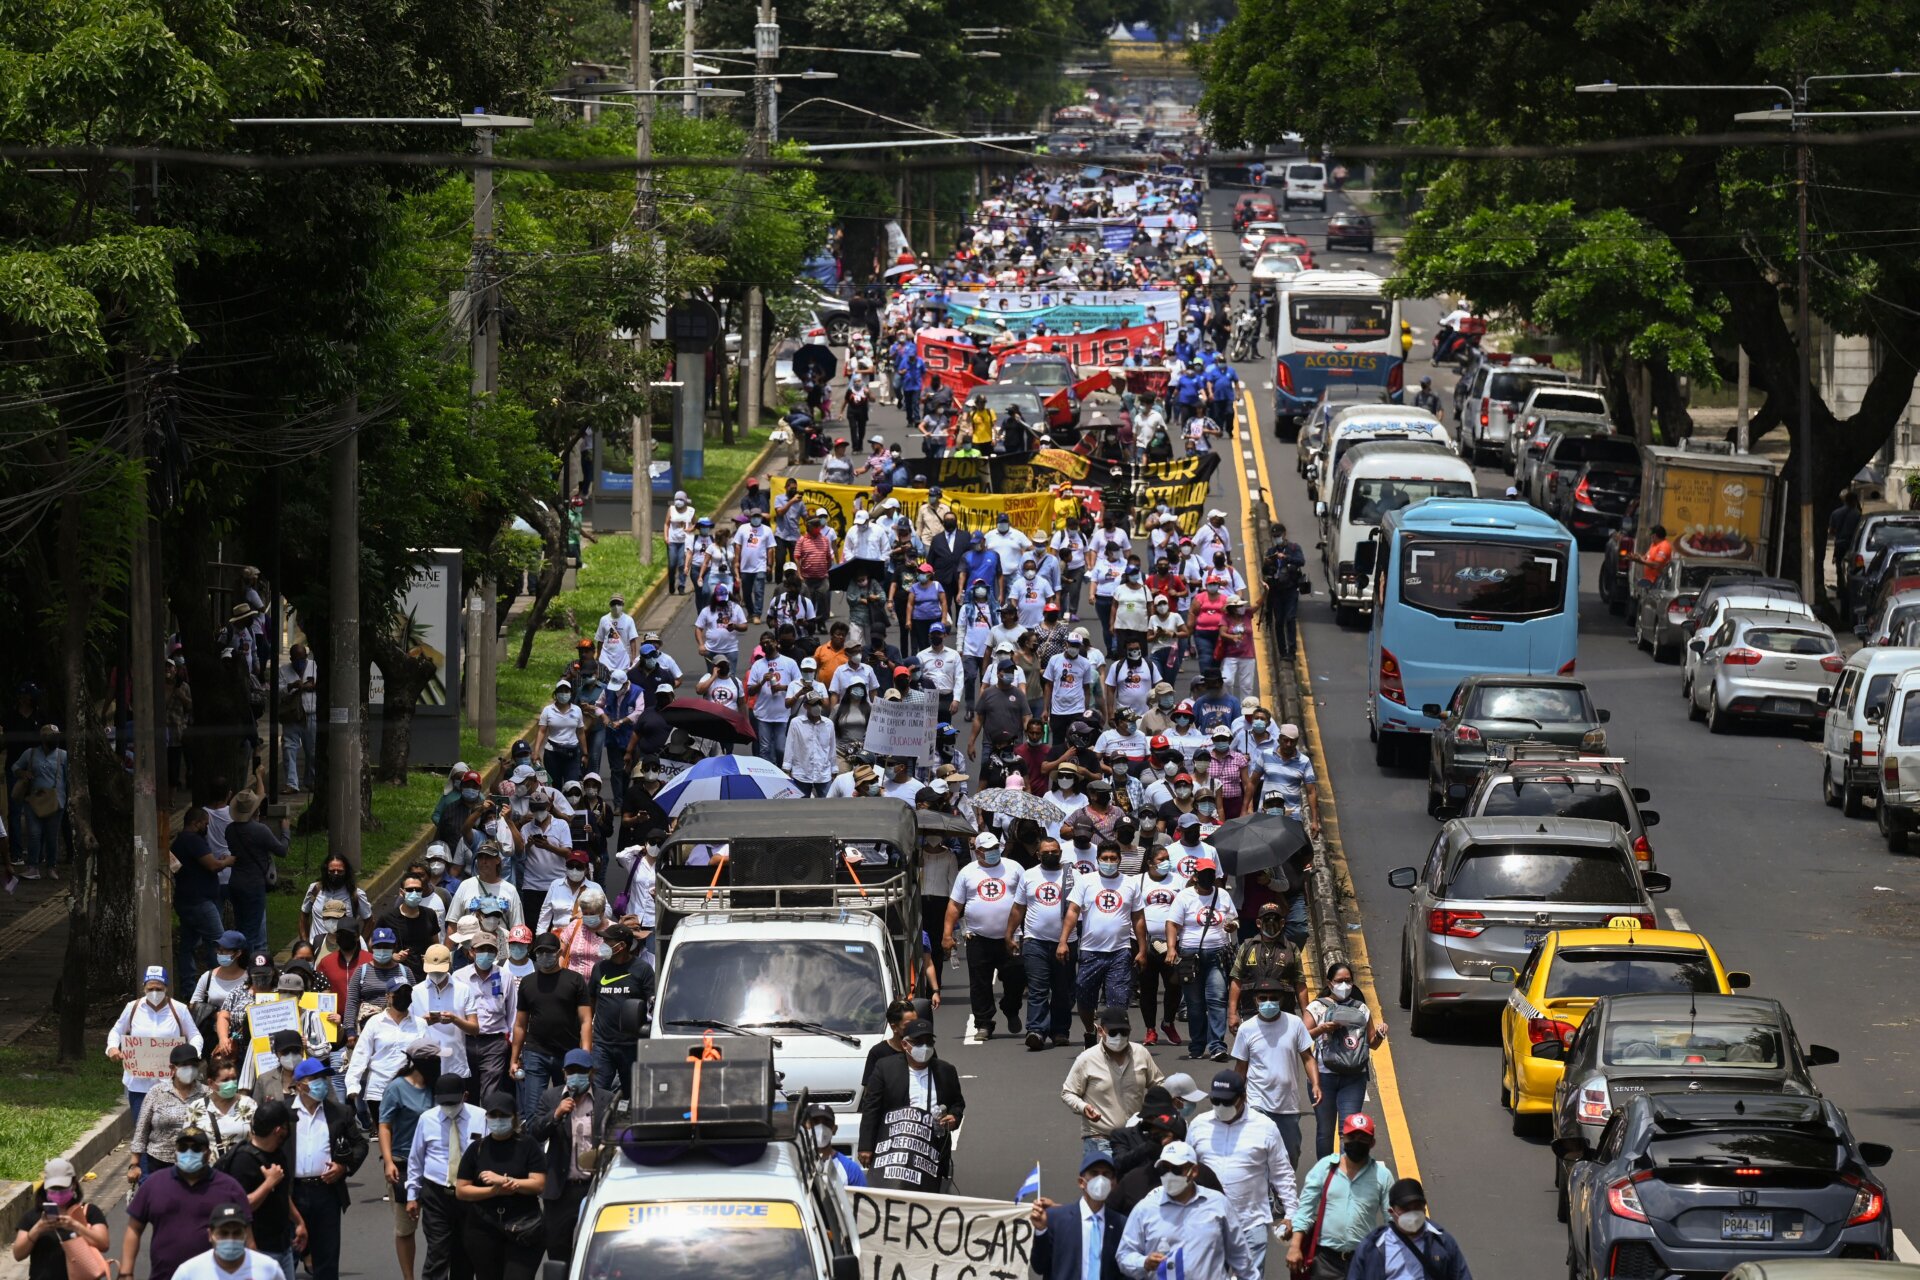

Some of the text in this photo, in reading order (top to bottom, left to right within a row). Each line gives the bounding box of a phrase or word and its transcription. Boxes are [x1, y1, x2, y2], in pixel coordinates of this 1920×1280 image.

[1304, 354, 1377, 370] ACOSTES
[1201, 703, 1231, 717] AMAZING
[1613, 918, 1637, 929] TAXI
[125, 1036, 142, 1048] NO!
[123, 1049, 136, 1060] NO!
[1613, 1085, 1645, 1093] SENTRA
[887, 1107, 920, 1122] EXIGIMOS
[889, 1121, 931, 1140] DEROGACION
[893, 1136, 928, 1155] REFORMA
[875, 1154, 885, 1167] LEY
[886, 1153, 895, 1165] DE
[896, 1152, 907, 1164] LA
[885, 1166, 921, 1184] JUDICIAL
[686, 1204, 769, 1217] SHURE
[853, 1192, 1032, 1265] DEROGAR
